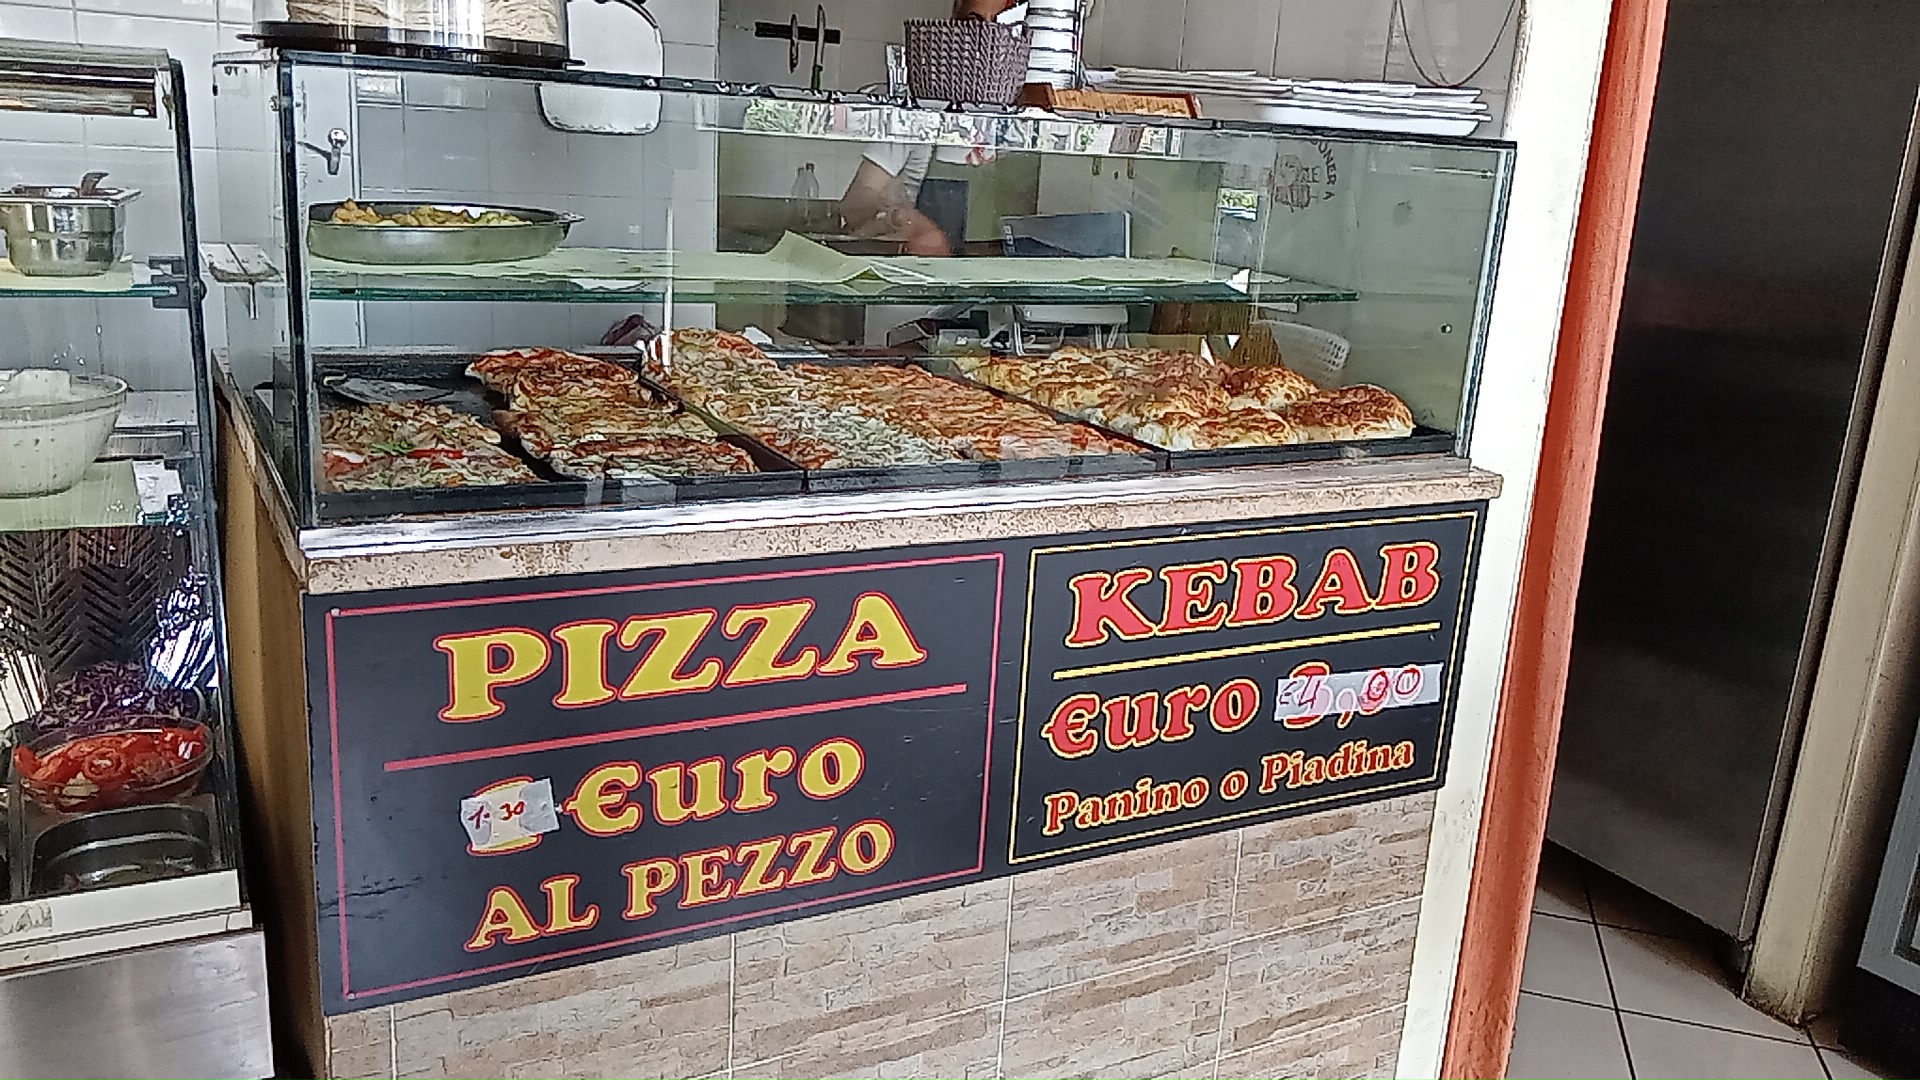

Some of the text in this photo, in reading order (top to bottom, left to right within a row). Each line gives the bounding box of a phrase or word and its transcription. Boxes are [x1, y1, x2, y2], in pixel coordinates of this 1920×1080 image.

[1064, 541, 1441, 648] KEBAB
[434, 592, 927, 723] PIZZA
[1042, 739, 1414, 836] Panino o Piadina
[465, 819, 894, 952] AL PEZZO
